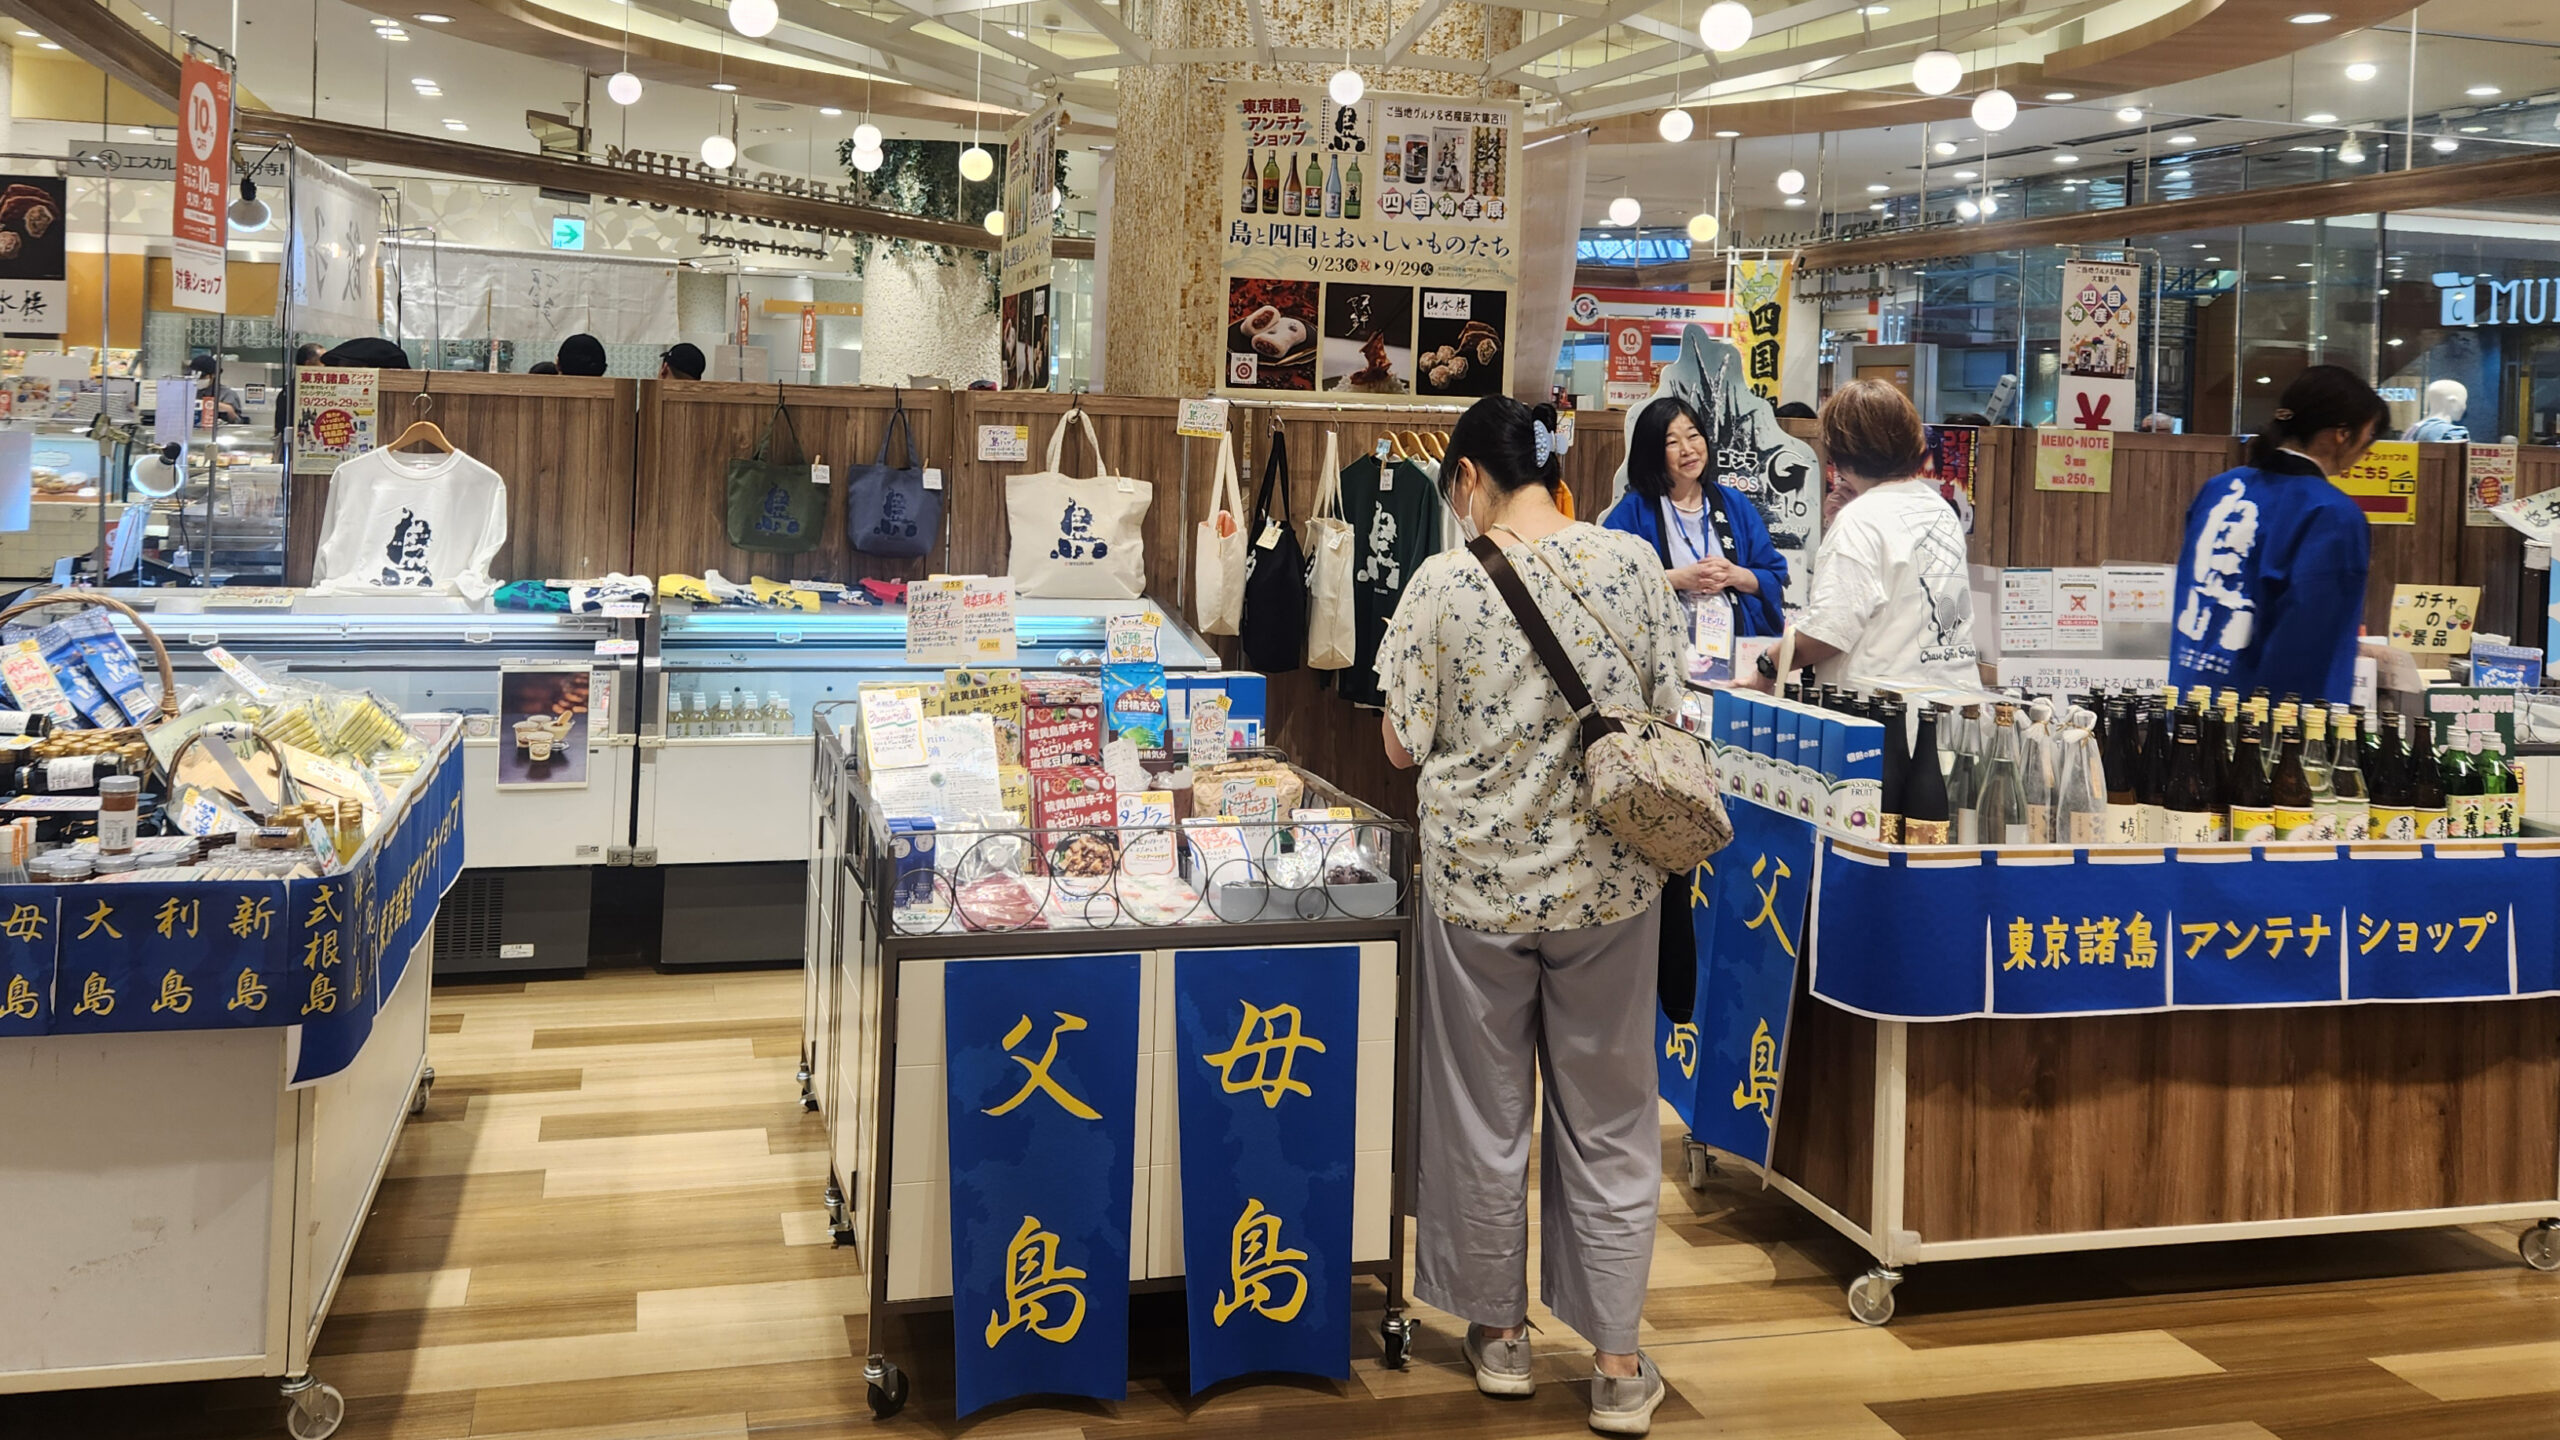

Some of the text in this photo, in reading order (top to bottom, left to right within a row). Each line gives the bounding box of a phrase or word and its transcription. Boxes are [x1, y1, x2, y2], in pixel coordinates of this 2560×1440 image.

[1242, 98, 1302, 114] 東京諸島
[1247, 115, 1304, 131] アンテナ
[1252, 131, 1307, 147] ショップ
[1382, 193, 1505, 219] 四国物産展
[1229, 219, 1510, 258] 島と四国とおいしいものたち
[176, 268, 222, 296] 対象ショップ
[2081, 290, 2121, 307] 四国
[1655, 306, 1697, 319] 崎陽軒
[2069, 306, 2131, 325] 物産展
[301, 373, 349, 384] 東京諸島
[1610, 391, 1648, 400] 対象ショップ
[1717, 451, 1759, 468] ゴジラ
[1718, 473, 1759, 492] EPOS
[2414, 591, 2458, 608] ガチャ
[2426, 612, 2440, 627] の
[2412, 629, 2448, 647] 景品
[1920, 649, 1943, 664] Chase
[949, 684, 1016, 702] 硫黄島唐辛子と
[1117, 699, 1161, 712] 柑橘気分
[1028, 721, 1095, 741] 硫黄島唐辛子と
[1029, 738, 1094, 758] 島セロリが香る
[1044, 791, 1113, 813] 硫黄島唐辛子と
[1851, 788, 1873, 797] FRUIT
[378, 862, 412, 960] 東京諸島
[301, 884, 344, 1016] 式根島
[2003, 910, 2499, 971] 東京諸島 アンテナ ショップ
[0, 903, 48, 1019] 母島
[73, 899, 123, 1016] 大島
[151, 897, 200, 1013] 利島
[227, 895, 276, 1011] 新島
[1732, 852, 1797, 1130] 父島
[1203, 999, 1326, 1327] 母島
[981, 1010, 1103, 1348] 父島
